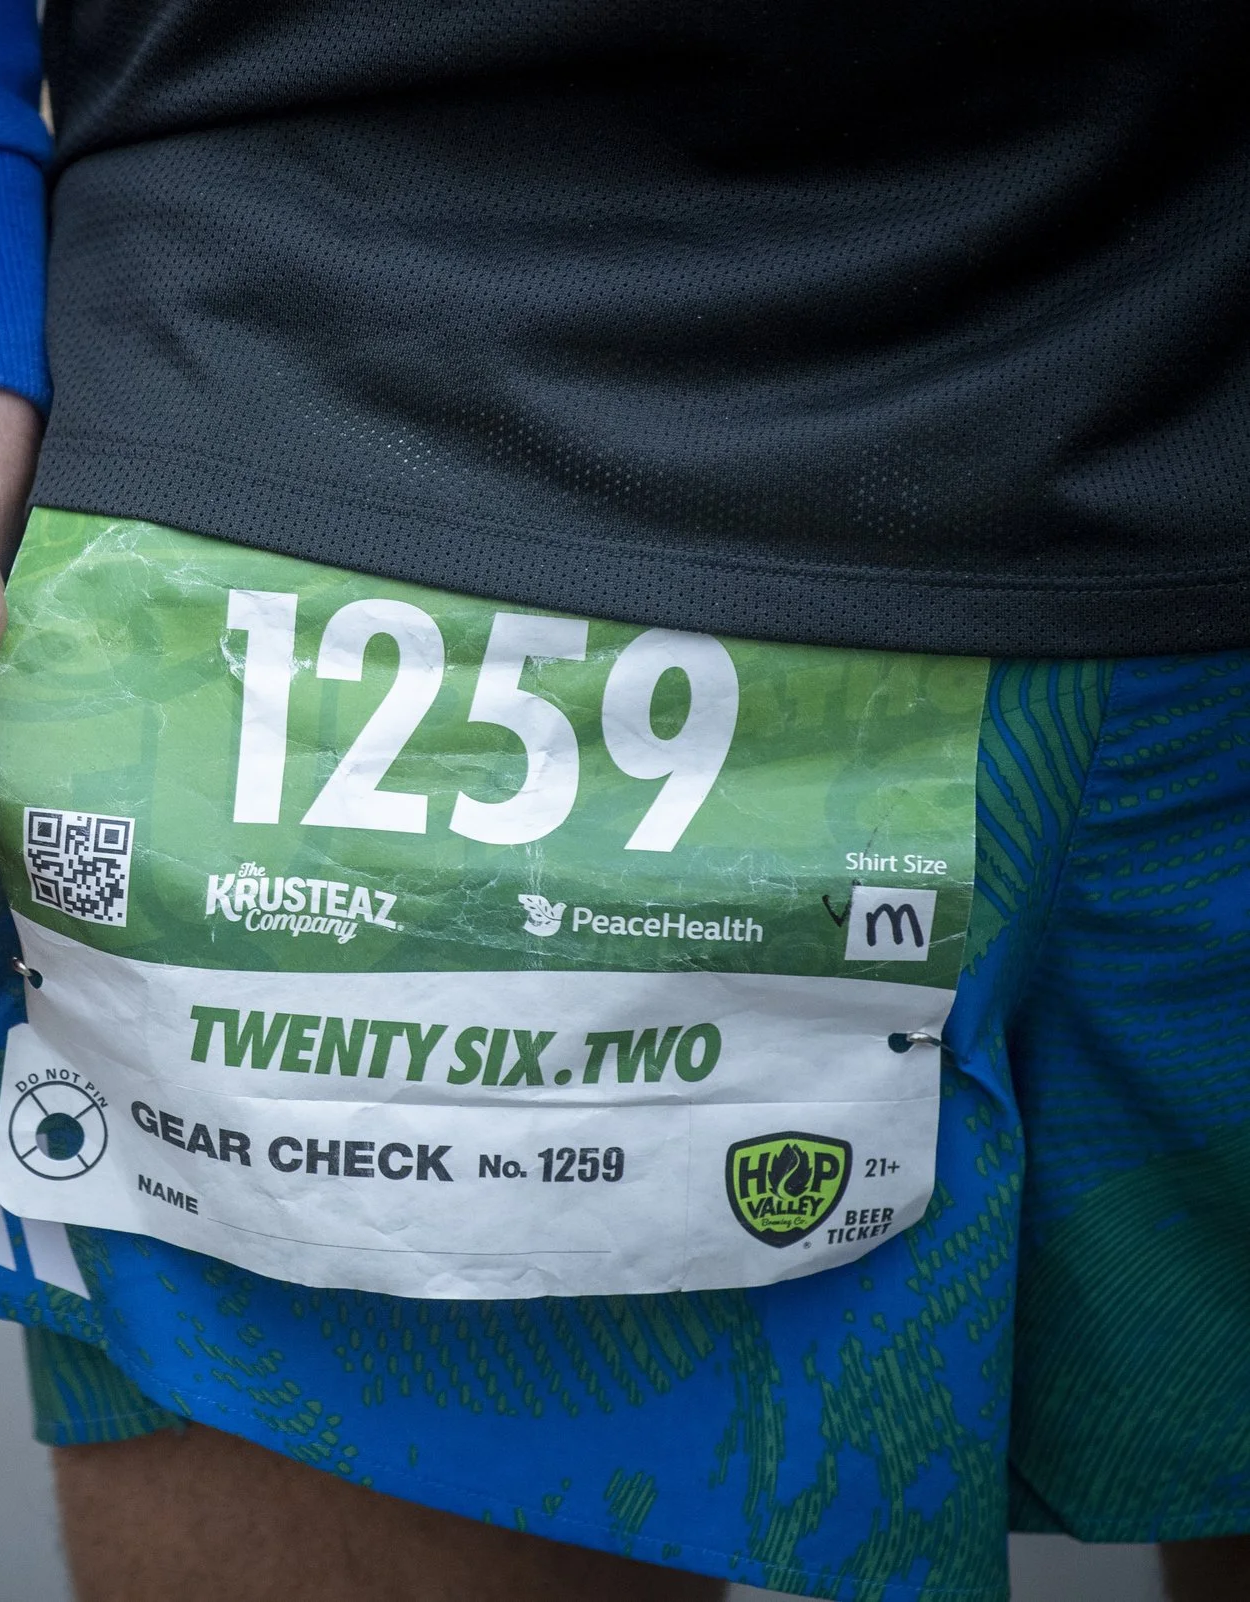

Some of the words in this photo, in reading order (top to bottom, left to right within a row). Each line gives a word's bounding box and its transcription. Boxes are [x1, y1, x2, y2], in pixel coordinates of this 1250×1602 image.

[226, 588, 740, 853] 1259
[238, 861, 266, 878] The
[845, 852, 898, 873] Shirt
[903, 854, 948, 875] Size
[205, 873, 398, 930] KRUSTEAZ
[245, 908, 359, 945] Company
[572, 906, 764, 943] PeaceHealth
[189, 1004, 449, 1083] TWENTY
[15, 1073, 39, 1094] DO
[45, 1068, 81, 1084] NOT
[84, 1081, 109, 1109] PIN
[130, 1100, 250, 1166] GEAR
[267, 1136, 454, 1182] CHECK
[478, 1153, 528, 1179] No.
[537, 1146, 625, 1183] 1259
[864, 1157, 900, 1178] 21+
[138, 1174, 199, 1215] NAME
[746, 1195, 826, 1220] VALLEY
[827, 1222, 892, 1245] TICKET
[844, 1207, 895, 1226] BEER
